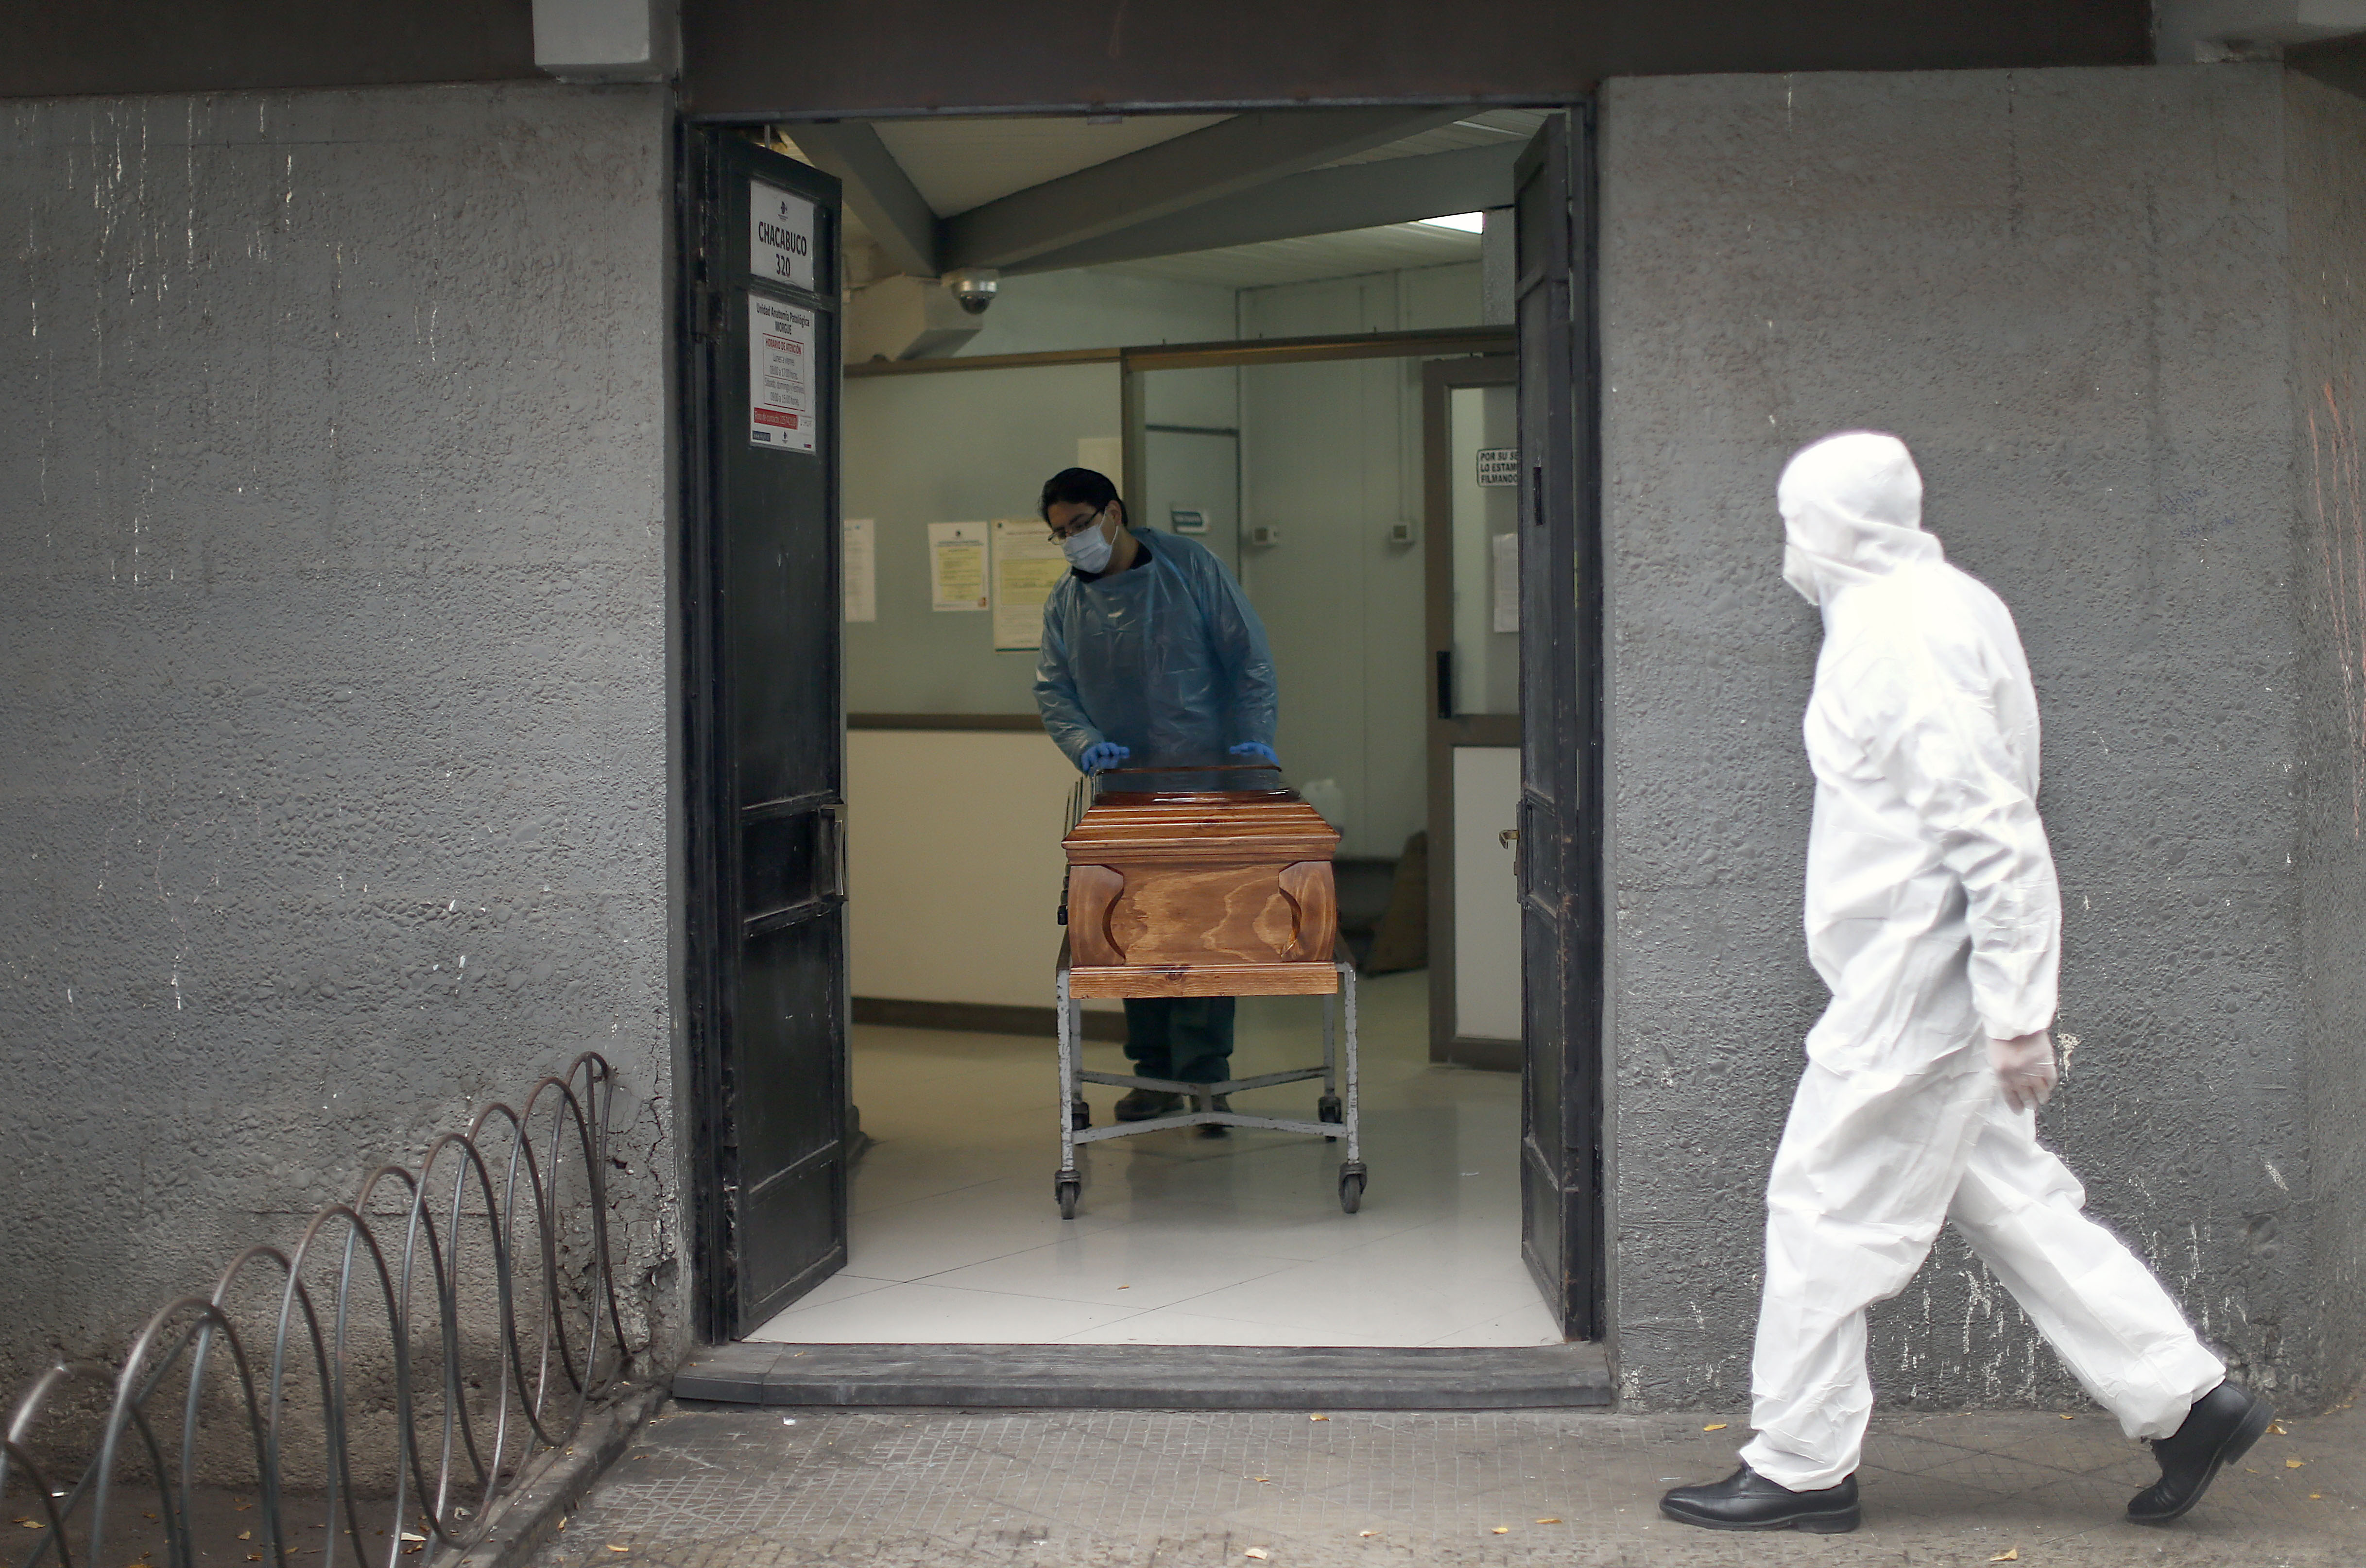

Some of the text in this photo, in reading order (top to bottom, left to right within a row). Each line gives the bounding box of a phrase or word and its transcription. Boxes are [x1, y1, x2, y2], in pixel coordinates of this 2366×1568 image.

[758, 221, 807, 256] CHACABUCO
[776, 254, 790, 277] 320
[756, 303, 770, 317] Unidad
[789, 312, 809, 328] Patológica
[775, 321, 791, 335] MORGUE
[766, 338, 780, 349] HORARIO
[781, 341, 786, 350] DE
[1481, 452, 1495, 460] POR
[1498, 452, 1507, 460] SU
[1481, 463, 1516, 472] LO ESTAM
